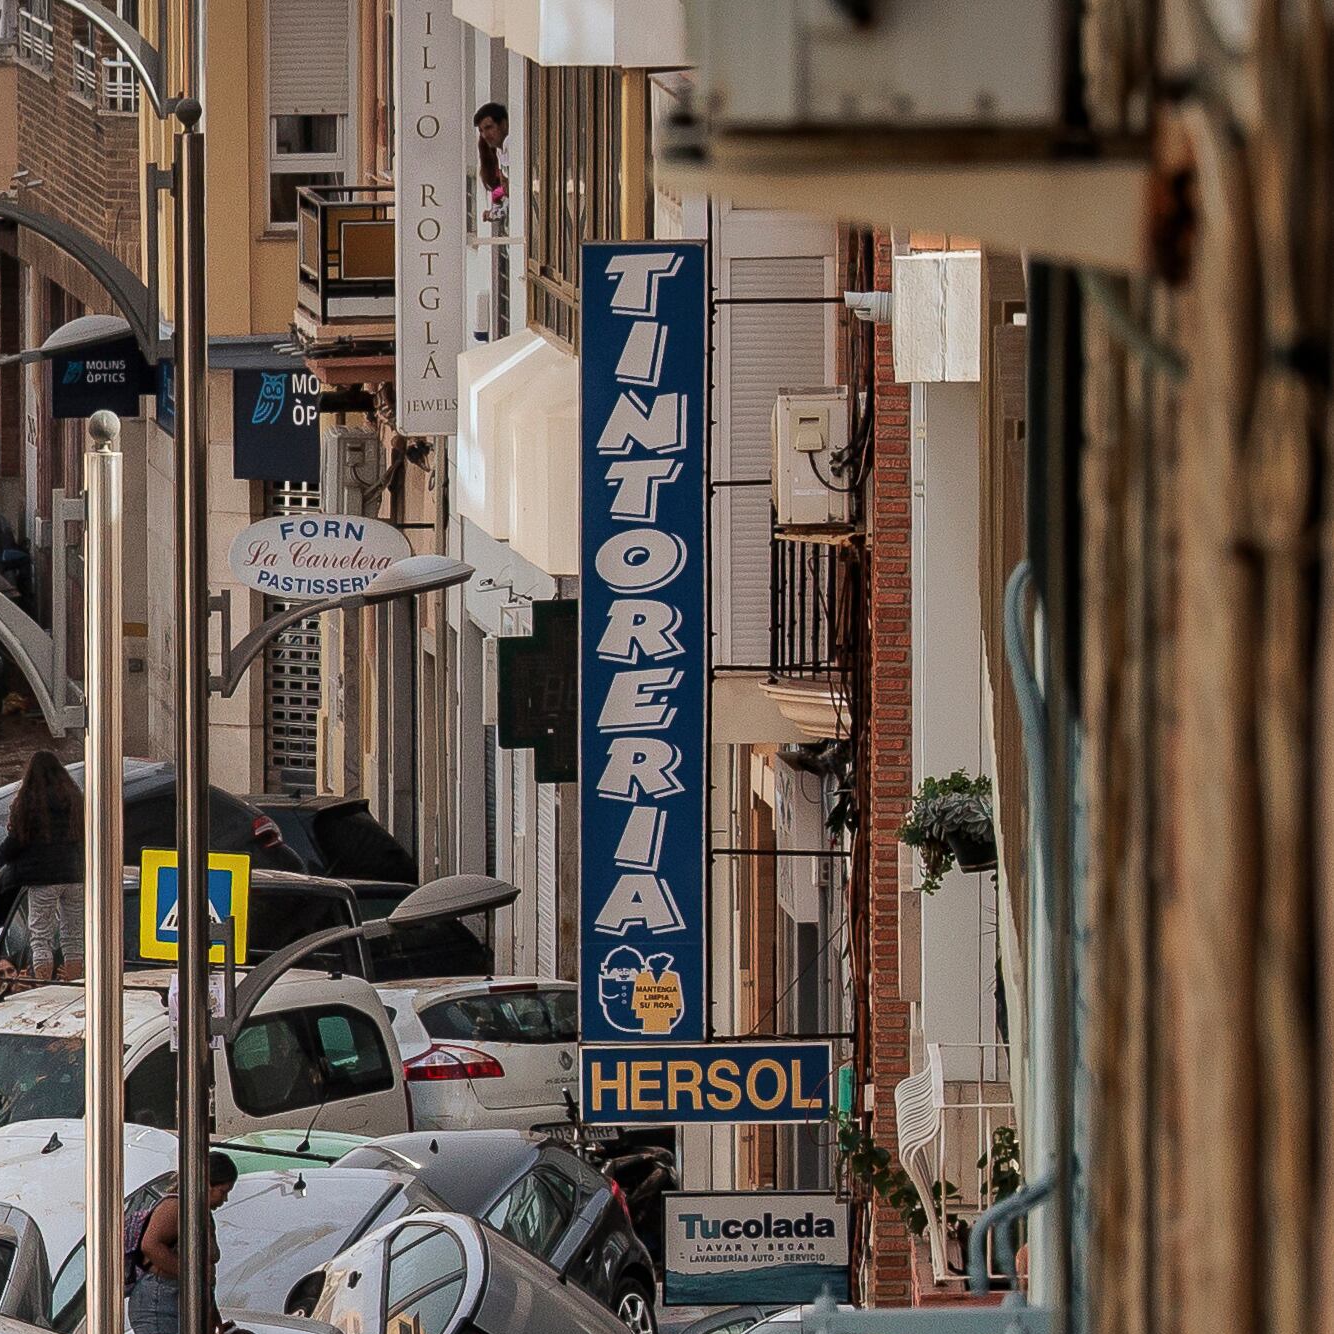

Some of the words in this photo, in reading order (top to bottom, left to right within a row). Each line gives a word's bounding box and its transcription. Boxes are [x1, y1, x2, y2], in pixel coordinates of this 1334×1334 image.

[416, 11, 440, 139] ILIO
[417, 183, 442, 379] ROTGLÁ
[86, 360, 126, 370] MOLINS
[86, 371, 126, 383] ÒPTICS
[406, 398, 458, 415] JEWELS
[279, 520, 365, 542] FORN
[244, 540, 278, 568] La
[288, 541, 393, 570] Carretera
[257, 569, 378, 595] PASTISSERI
[595, 252, 687, 936] TINTORERIA
[591, 1058, 822, 1111] HERSOL
[678, 1212, 836, 1240] Tucolada
[689, 1253, 749, 1263] LAVANDERÍAS
[751, 1254, 775, 1262] AUTO
[783, 1254, 826, 1262] SERVICIO
[696, 1243, 743, 1252] LAVAR
[751, 1243, 759, 1252] Y
[767, 1243, 815, 1251] SECAR
